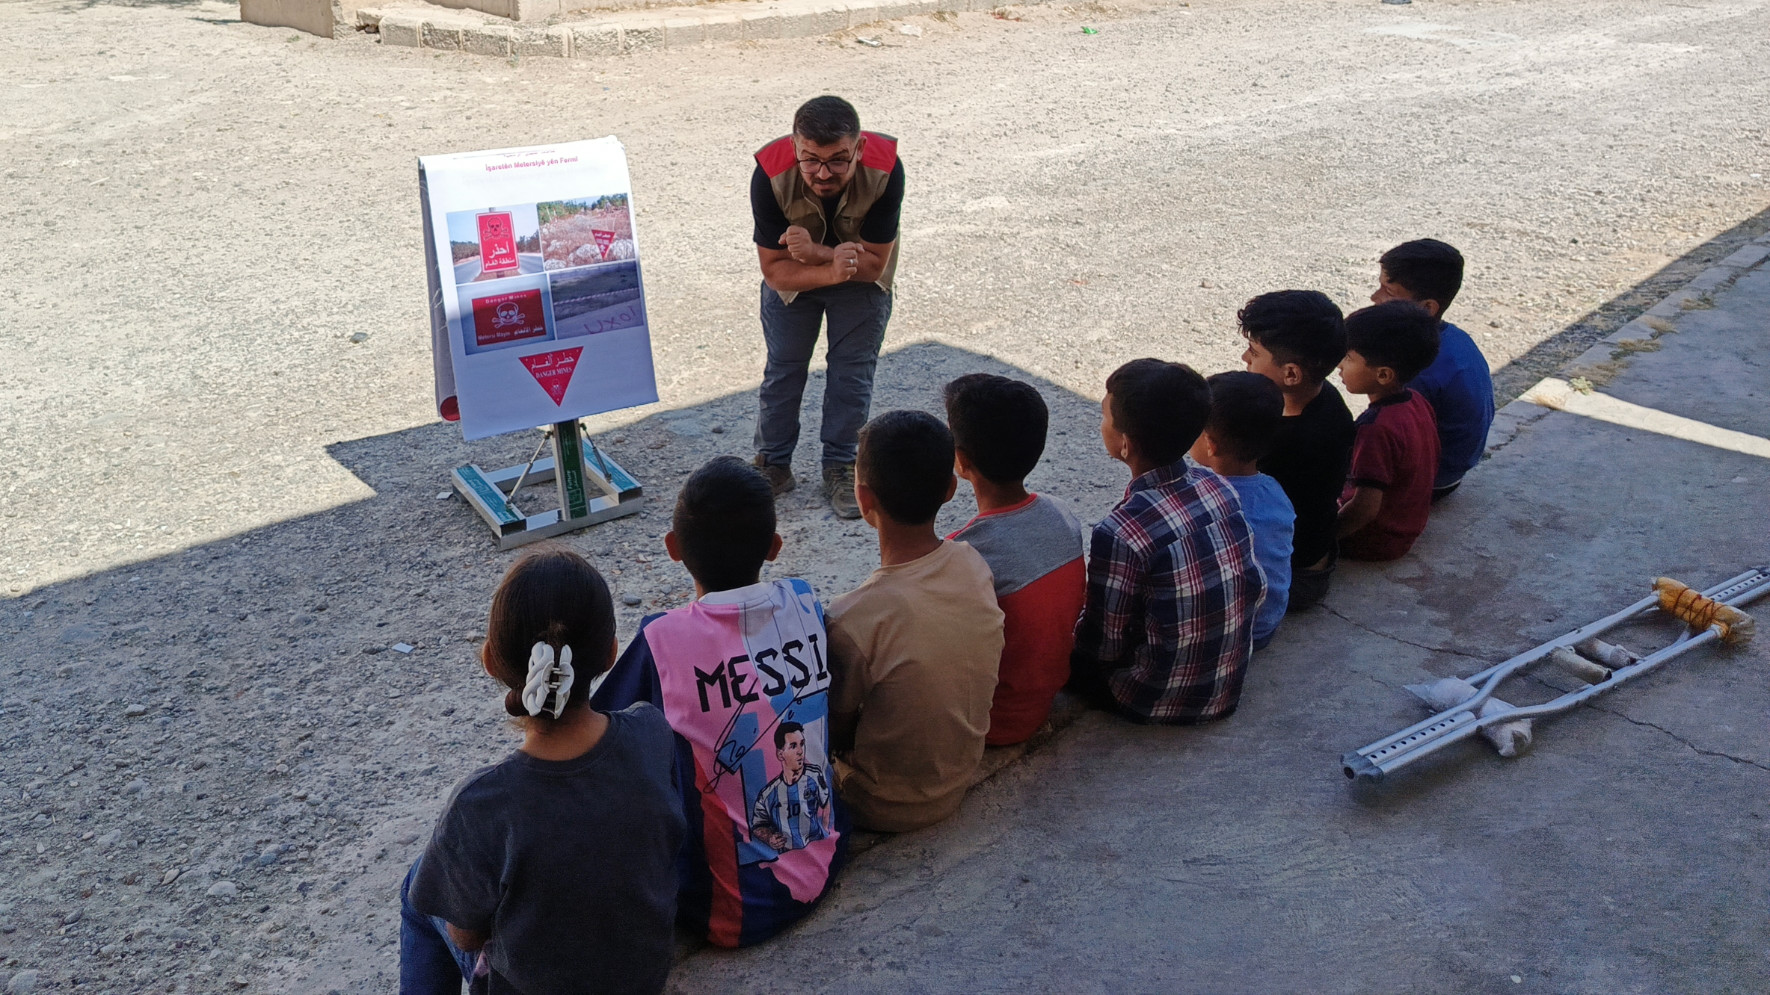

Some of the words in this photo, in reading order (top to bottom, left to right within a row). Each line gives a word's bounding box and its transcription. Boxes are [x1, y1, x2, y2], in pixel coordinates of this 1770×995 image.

[485, 296, 508, 304] Danger
[555, 352, 575, 367] خطر
[535, 368, 556, 378] DANGER
[556, 367, 573, 375] MINES
[693, 633, 830, 713] MESSI
[786, 801, 801, 819] 10
